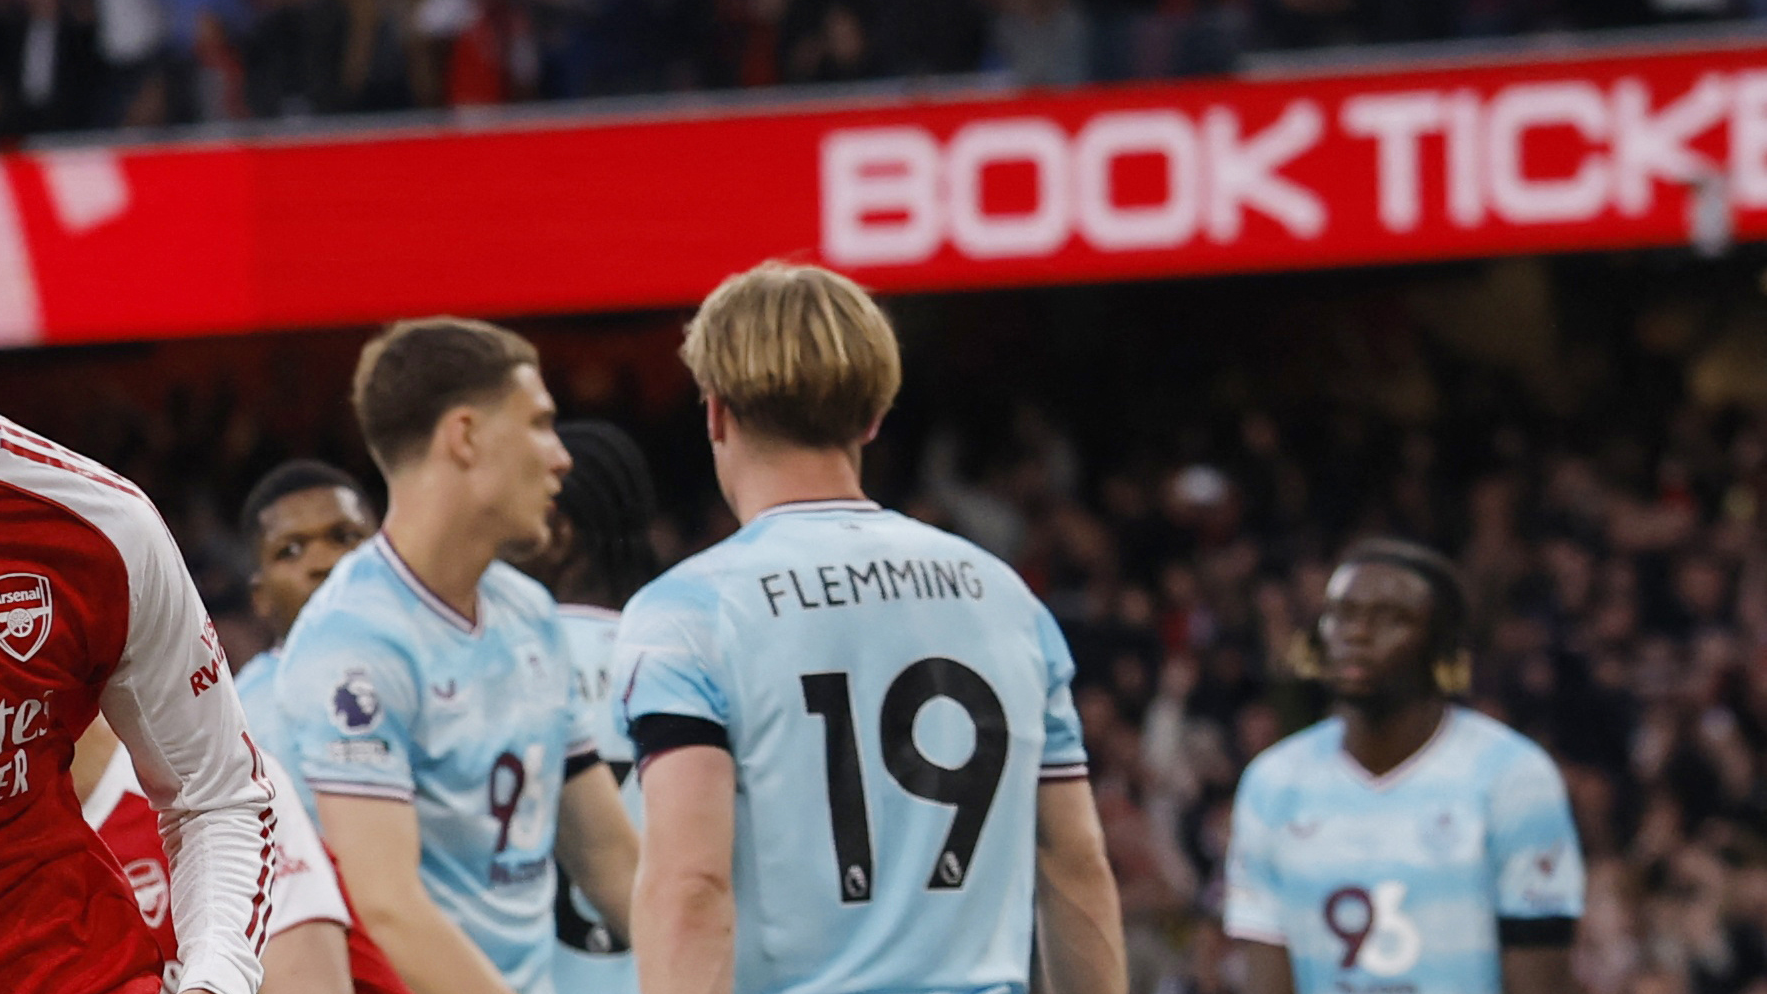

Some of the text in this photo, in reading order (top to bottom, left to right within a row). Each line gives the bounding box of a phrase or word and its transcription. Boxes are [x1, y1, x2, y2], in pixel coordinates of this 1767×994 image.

[819, 100, 1328, 267] BOOK
[759, 559, 983, 617] FLEMMING
[799, 656, 1010, 904] 19
